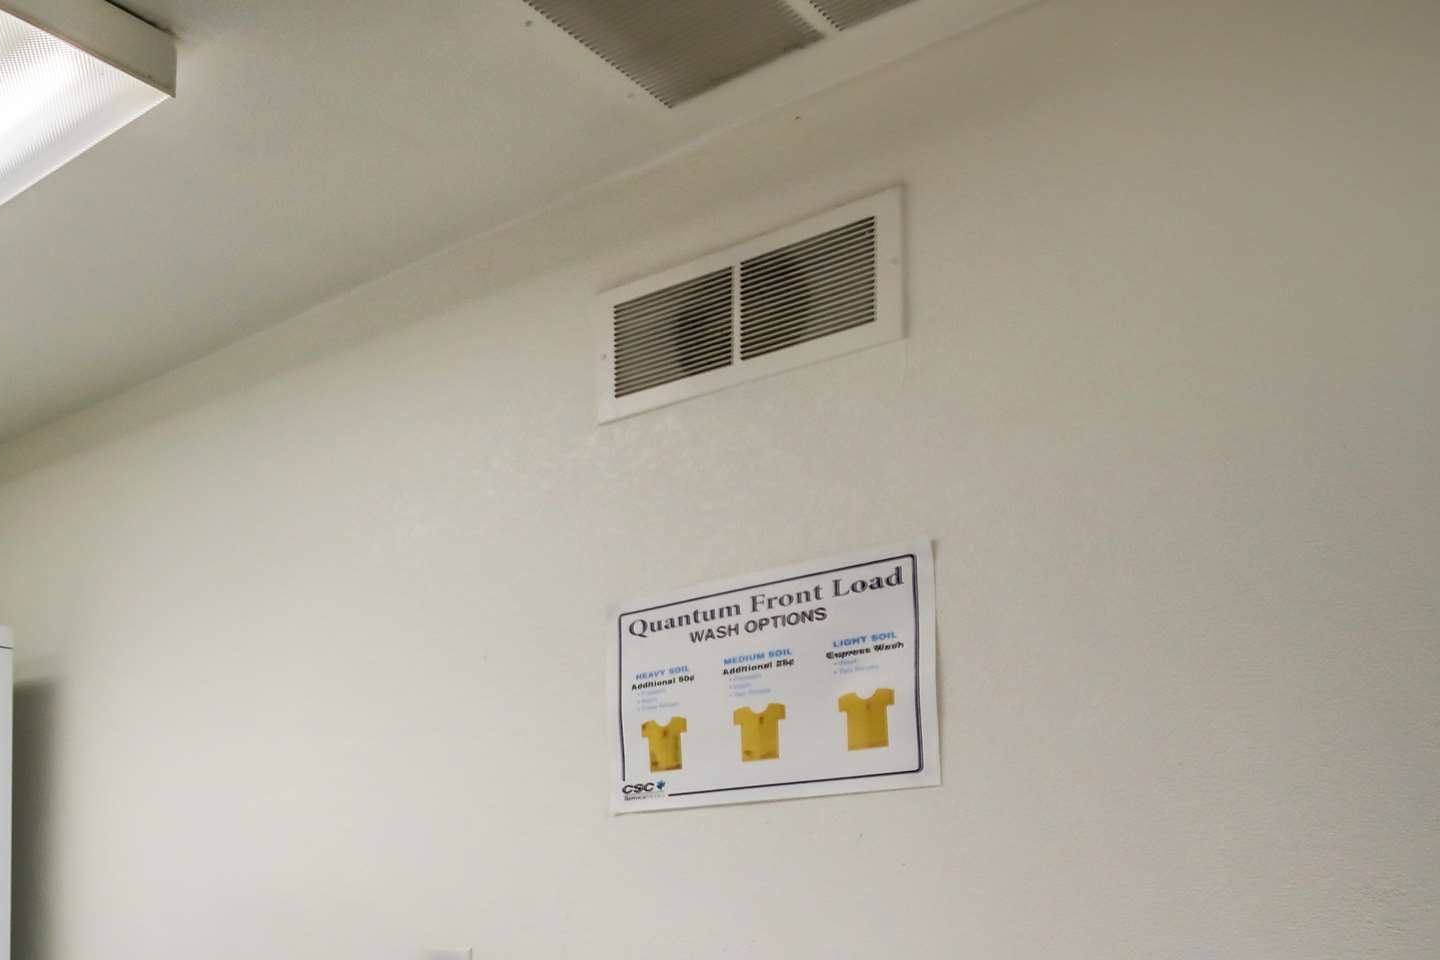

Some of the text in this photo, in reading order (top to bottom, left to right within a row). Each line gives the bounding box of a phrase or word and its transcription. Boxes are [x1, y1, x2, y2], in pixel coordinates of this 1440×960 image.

[629, 566, 905, 638] Quantum Front Load
[690, 607, 828, 643] WASH OPTIONS
[833, 631, 896, 647] LIGHT SOIL
[724, 648, 792, 664] MEDIUM SOIL
[636, 665, 688, 680] HEAVY SOIL
[723, 661, 772, 675] Additional
[632, 677, 676, 691] Additional
[622, 782, 655, 794] CSC
